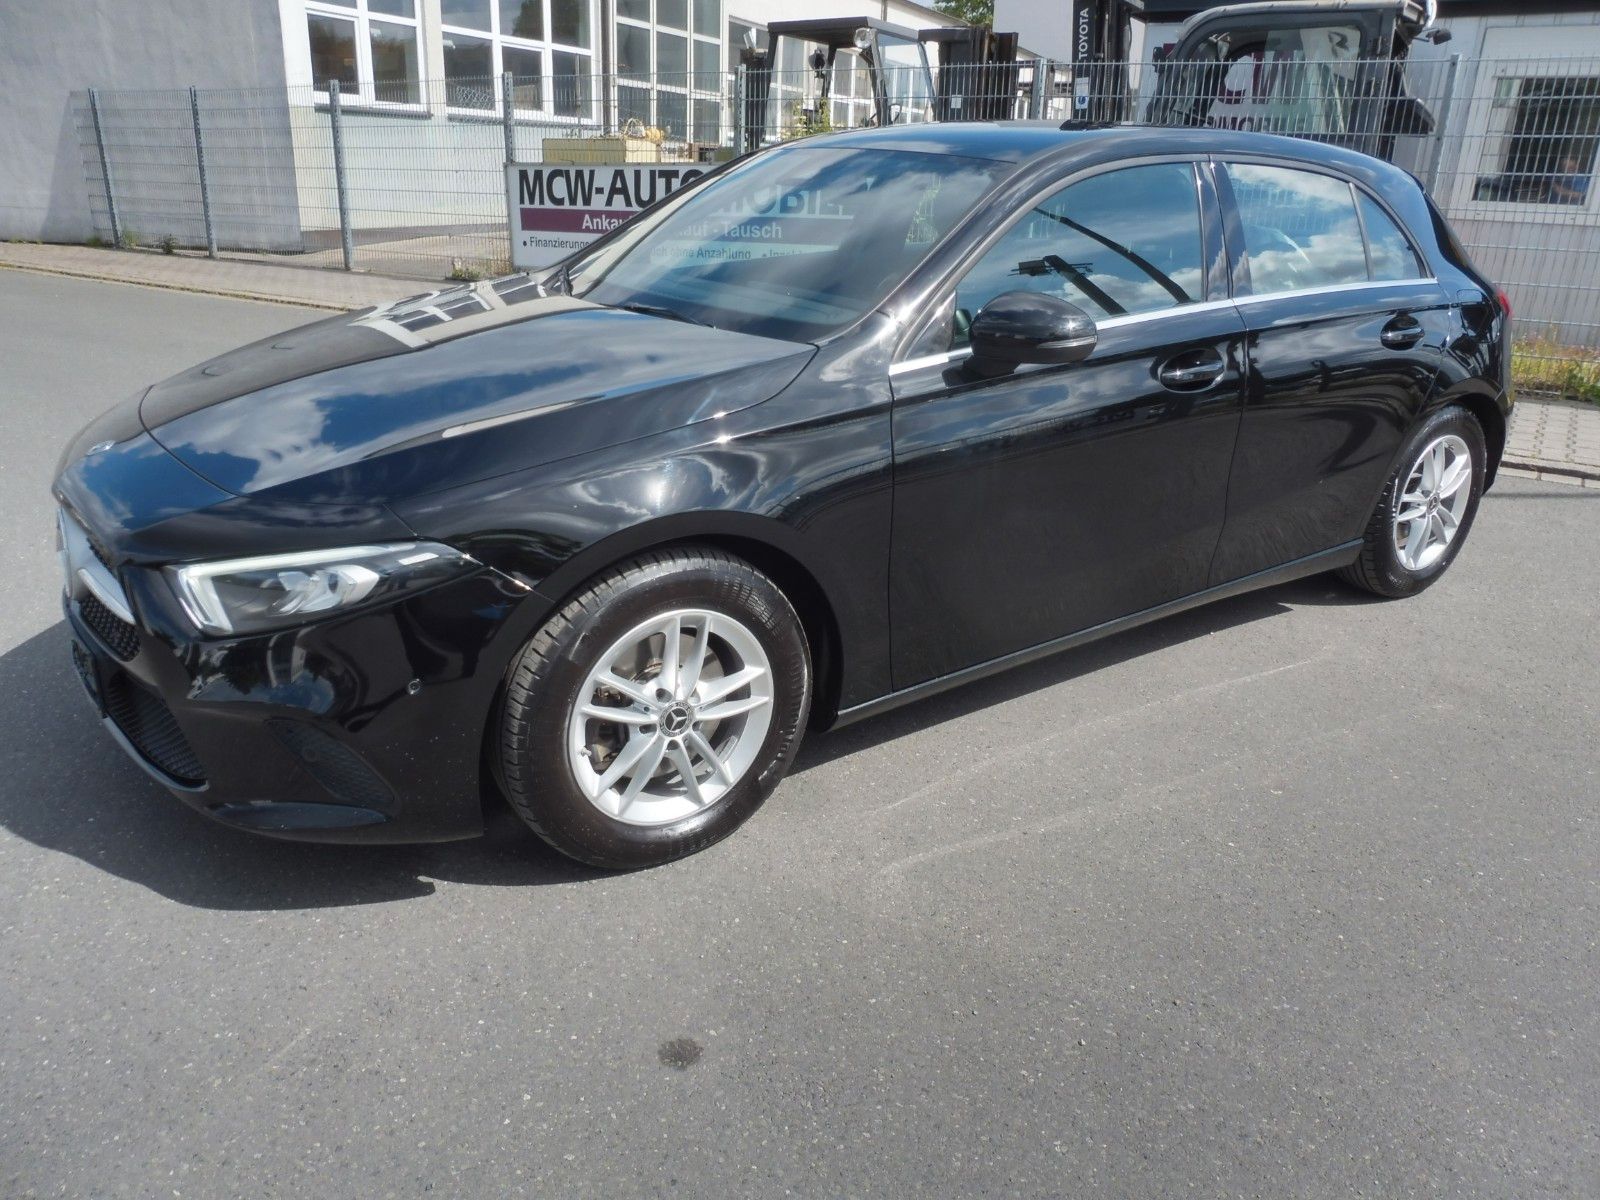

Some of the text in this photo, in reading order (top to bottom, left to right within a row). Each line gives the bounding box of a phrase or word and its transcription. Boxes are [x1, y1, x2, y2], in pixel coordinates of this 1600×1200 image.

[1078, 7, 1089, 60] TOYOTA
[582, 213, 631, 230] Anka
[721, 221, 782, 239] Tausch
